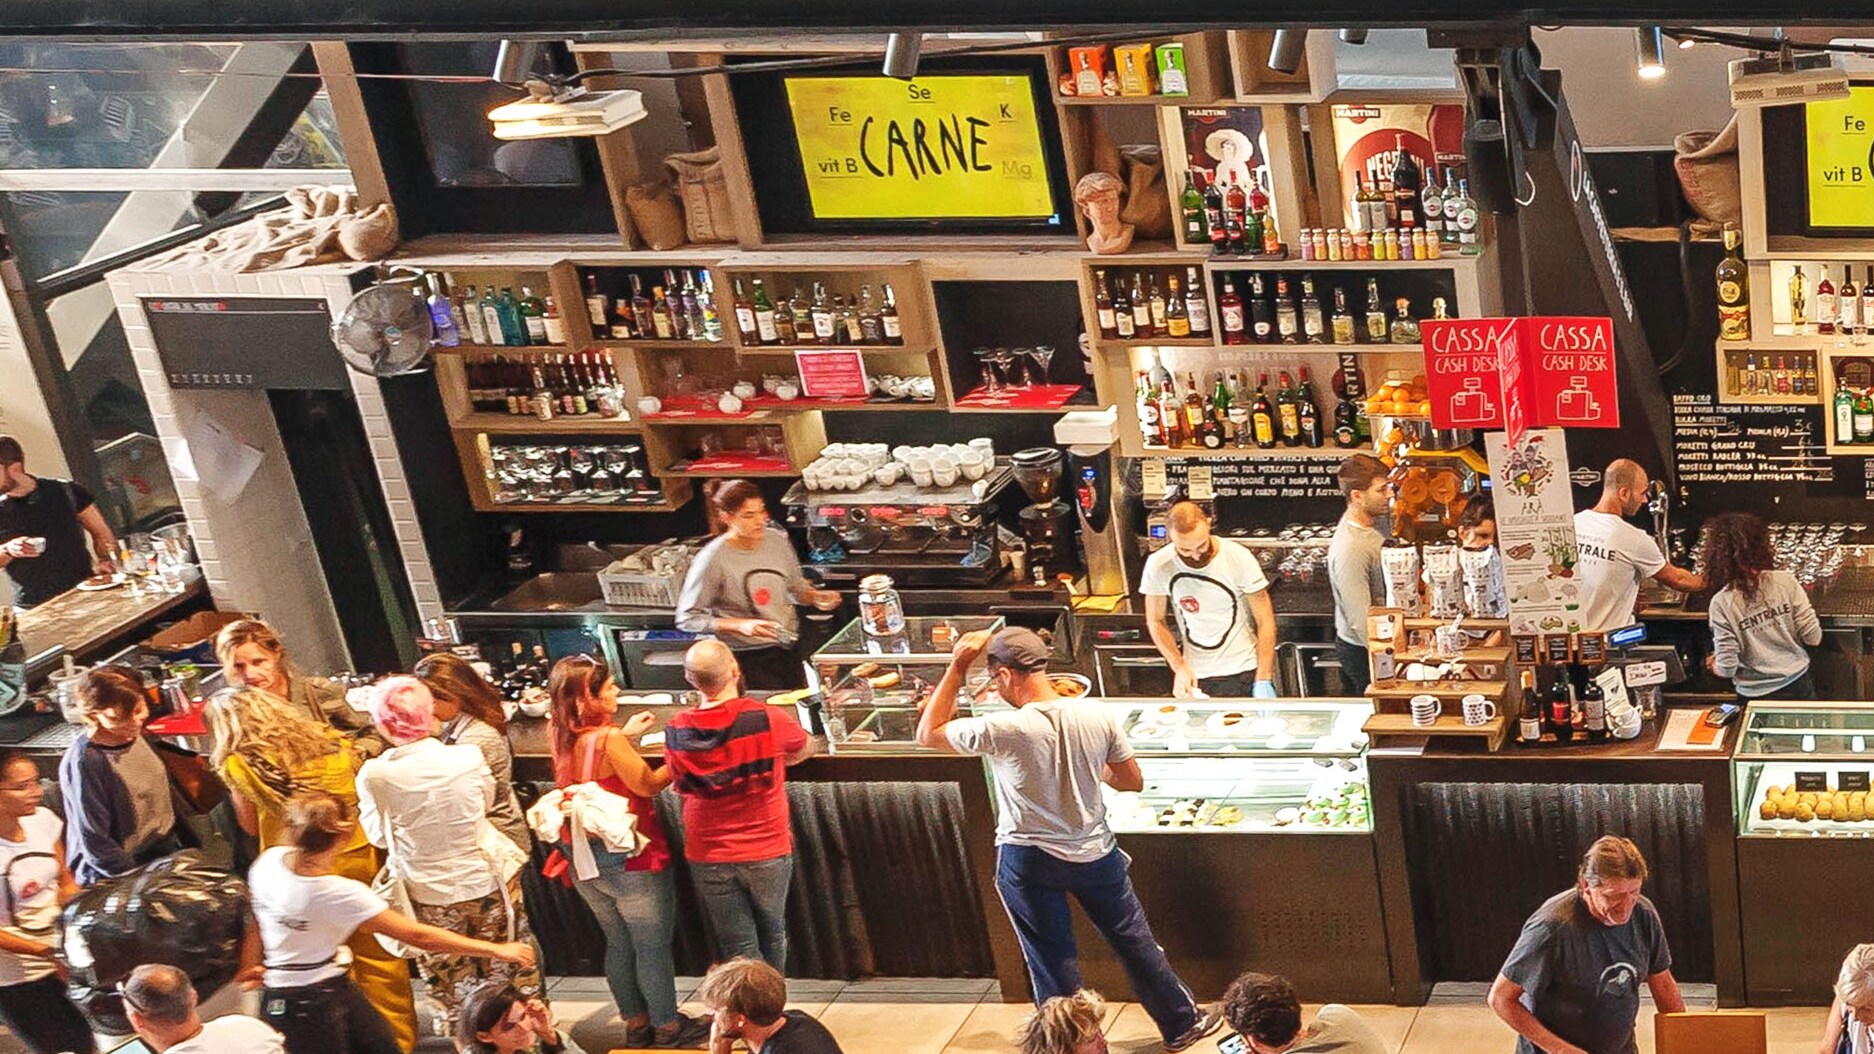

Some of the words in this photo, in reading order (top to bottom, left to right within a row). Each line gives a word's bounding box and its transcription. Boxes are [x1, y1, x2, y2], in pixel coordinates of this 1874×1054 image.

[907, 84, 932, 100] Se
[829, 107, 851, 122] Fe
[1000, 104, 1011, 118] K
[1187, 109, 1227, 117] MARTINI
[1336, 109, 1379, 117] MARTINI
[1844, 115, 1866, 131] Fe
[860, 114, 992, 180] CARNE
[818, 158, 840, 174] vit
[846, 158, 859, 174] B
[1824, 166, 1845, 182] vit
[1852, 166, 1863, 181] B
[1432, 326, 1498, 353] CASSA
[1540, 324, 1607, 352] CASSA
[1435, 356, 1467, 374] CASH
[1543, 355, 1574, 371] CASH
[1579, 355, 1608, 371] DESK
[1578, 542, 1616, 562] TRALE
